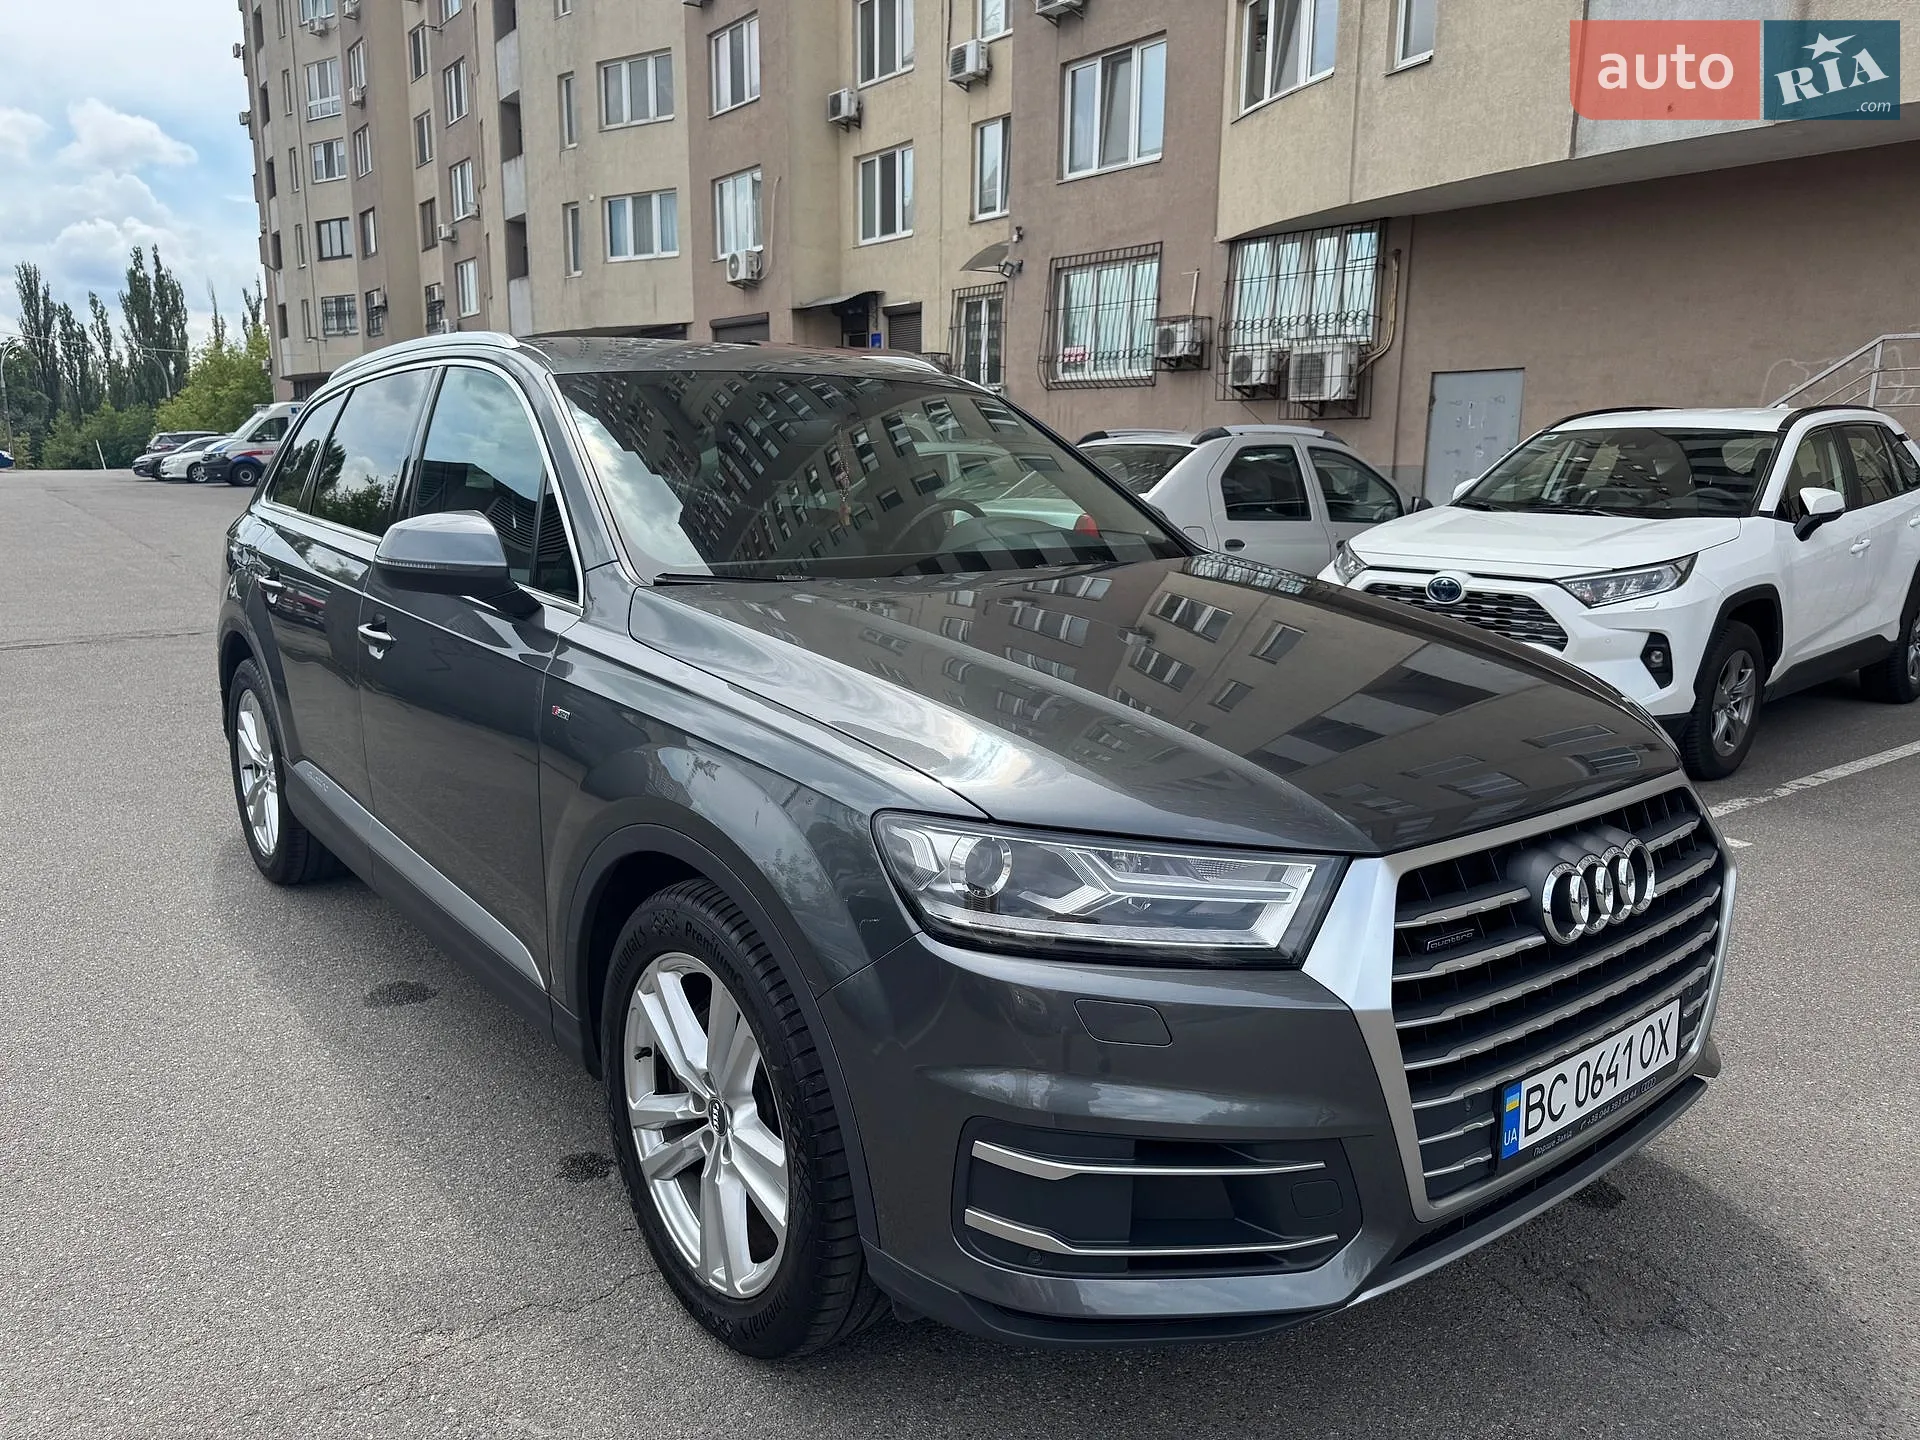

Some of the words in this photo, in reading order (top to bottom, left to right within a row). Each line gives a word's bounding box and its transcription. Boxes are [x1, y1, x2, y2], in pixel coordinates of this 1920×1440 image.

[1523, 1072, 1568, 1138] BC
[1574, 1034, 1634, 1108] 0641
[1639, 1011, 1673, 1070] OX
[1503, 1127, 1518, 1147] UA
